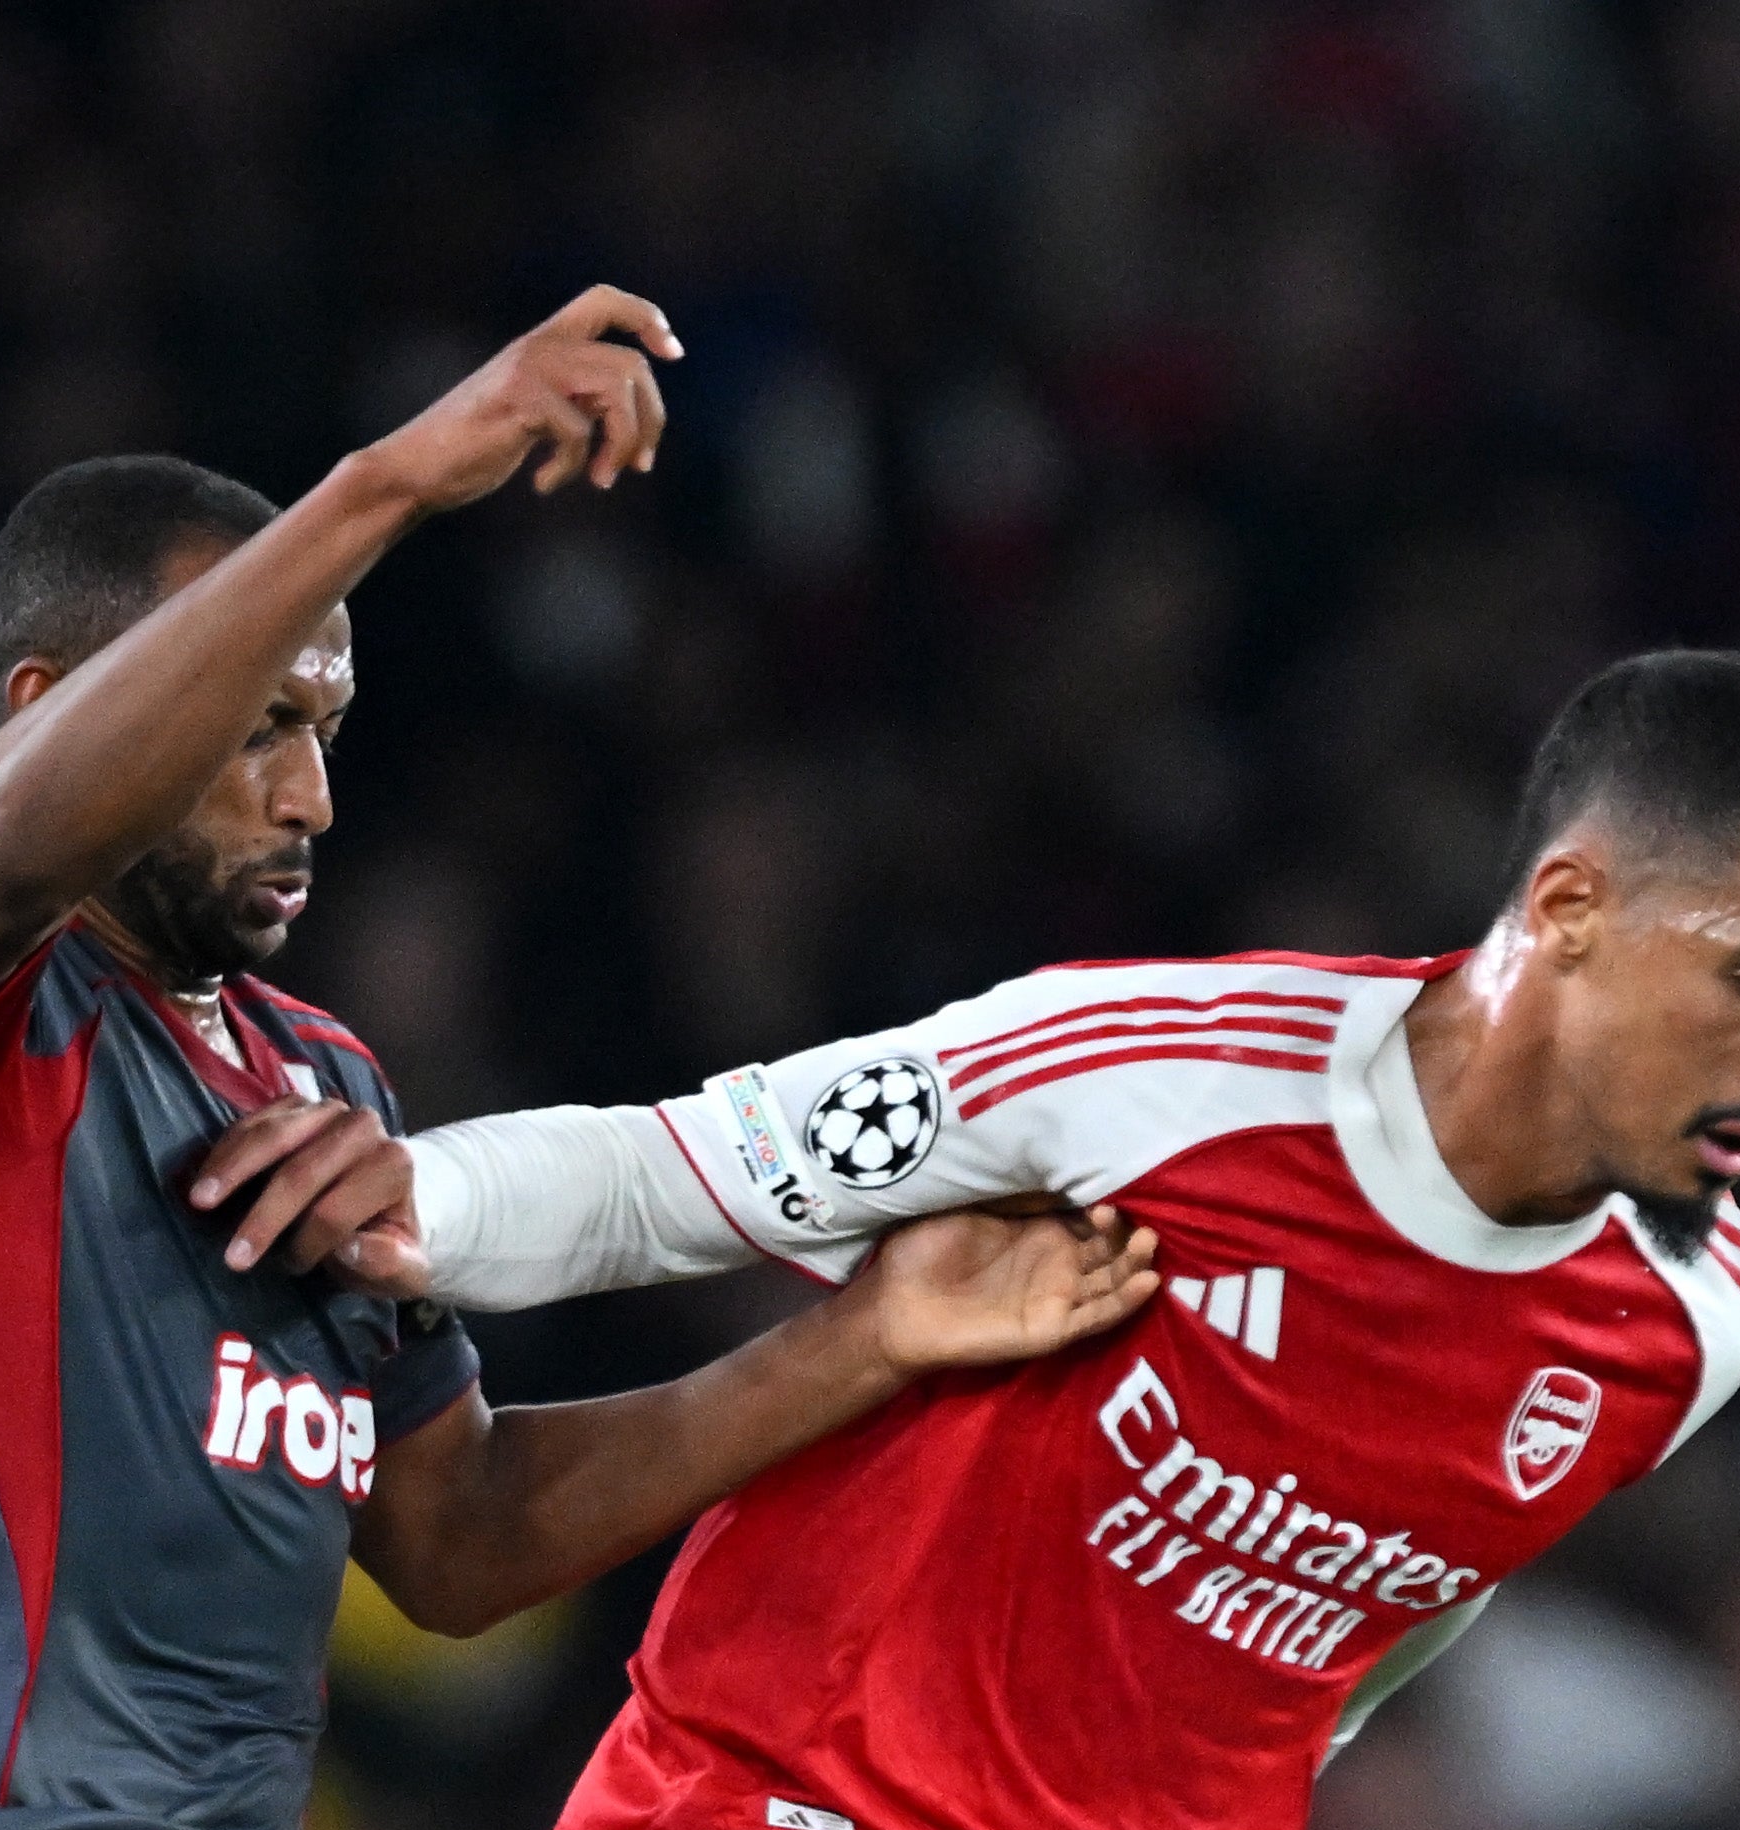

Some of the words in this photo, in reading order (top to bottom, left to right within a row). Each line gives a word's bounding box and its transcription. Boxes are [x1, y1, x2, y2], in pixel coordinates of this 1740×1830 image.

[1086, 1495, 1202, 1587] FLY
[1175, 1564, 1367, 1669] BETTER
[1097, 1357, 1480, 1609] Emirates
